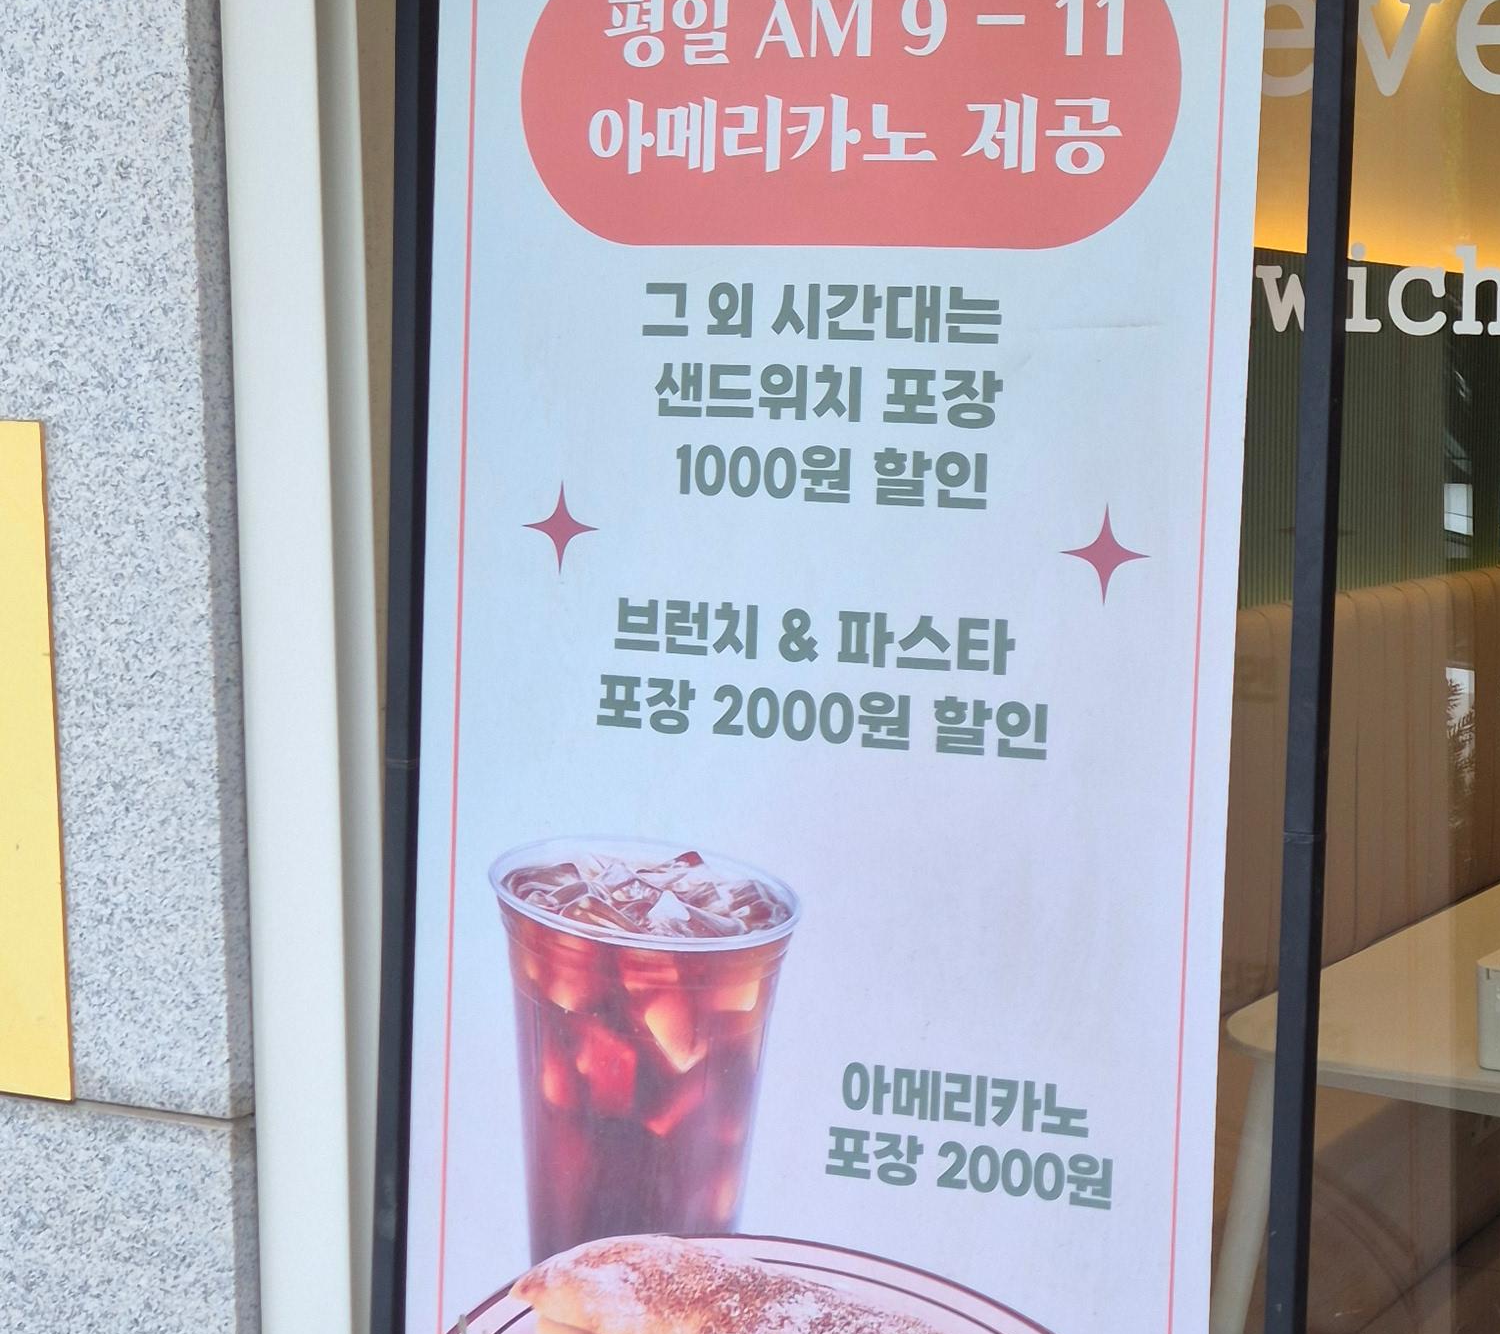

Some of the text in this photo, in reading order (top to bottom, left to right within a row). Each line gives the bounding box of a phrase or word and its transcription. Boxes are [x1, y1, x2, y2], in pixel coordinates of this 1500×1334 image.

[588, 93, 1123, 175] 아메리카노 제공
[642, 281, 1002, 344] 그 외 시간대는
[654, 361, 1003, 429] 샌드위치 포장
[676, 443, 988, 510] 1000원 할인
[613, 597, 1016, 676] 브런치 & 파스타
[596, 673, 1048, 761] 포장 2000원 할인
[842, 1061, 1089, 1139] 아메리카노
[825, 1126, 1114, 1210] 포장 2000원
